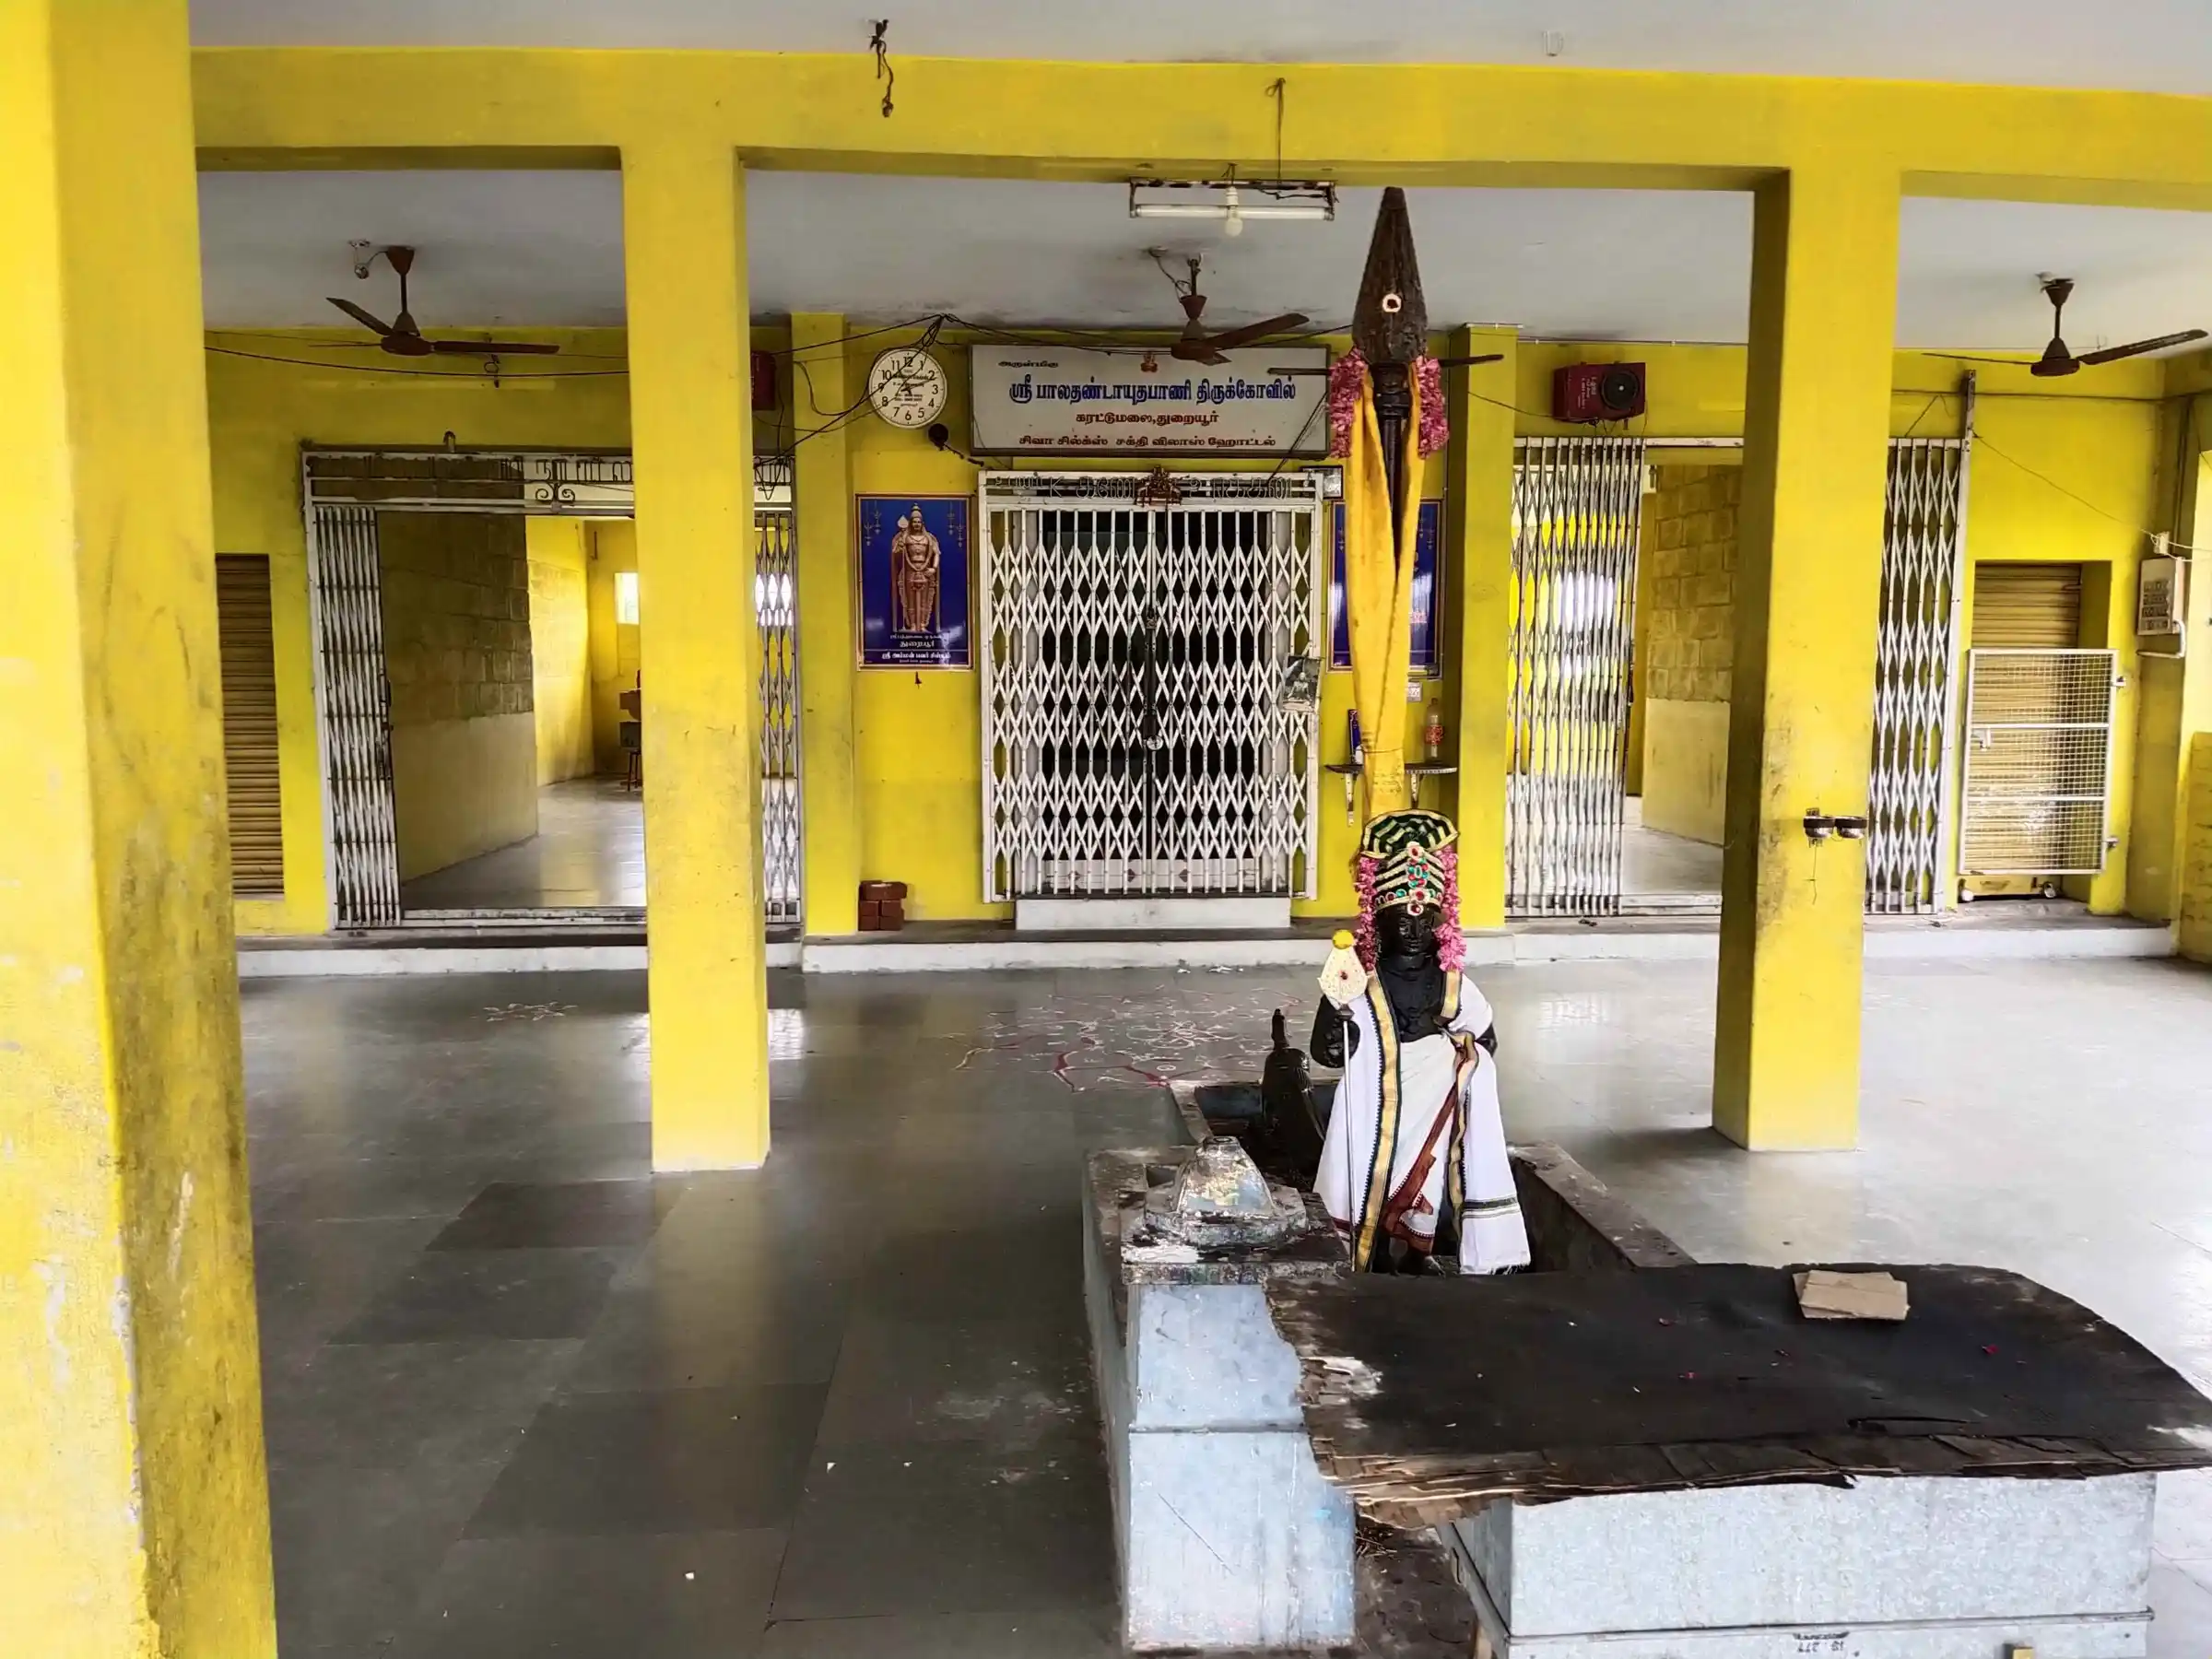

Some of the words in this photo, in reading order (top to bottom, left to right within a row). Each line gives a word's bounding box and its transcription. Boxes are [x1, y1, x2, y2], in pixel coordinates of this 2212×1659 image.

[891, 360, 900, 371] 11
[903, 356, 913, 368] 12
[882, 370, 892, 381] 10
[928, 370, 937, 381] 2
[932, 383, 938, 394] 3
[1009, 373, 1032, 404] ஸ்ரீ
[1036, 376, 1192, 406] பாலதண்டாயுதபாணி
[1196, 376, 1296, 405] திருக்கோவில்
[882, 396, 888, 406] 8
[928, 397, 935, 407] 4
[893, 406, 900, 418] 7
[905, 410, 912, 420] 6
[918, 407, 924, 418] 5
[1018, 434, 1054, 445] சிவா
[1057, 434, 1109, 446] சில்க்ஸ்
[1115, 434, 1149, 448] சக்தி
[1152, 435, 1206, 446] விலாஸ்
